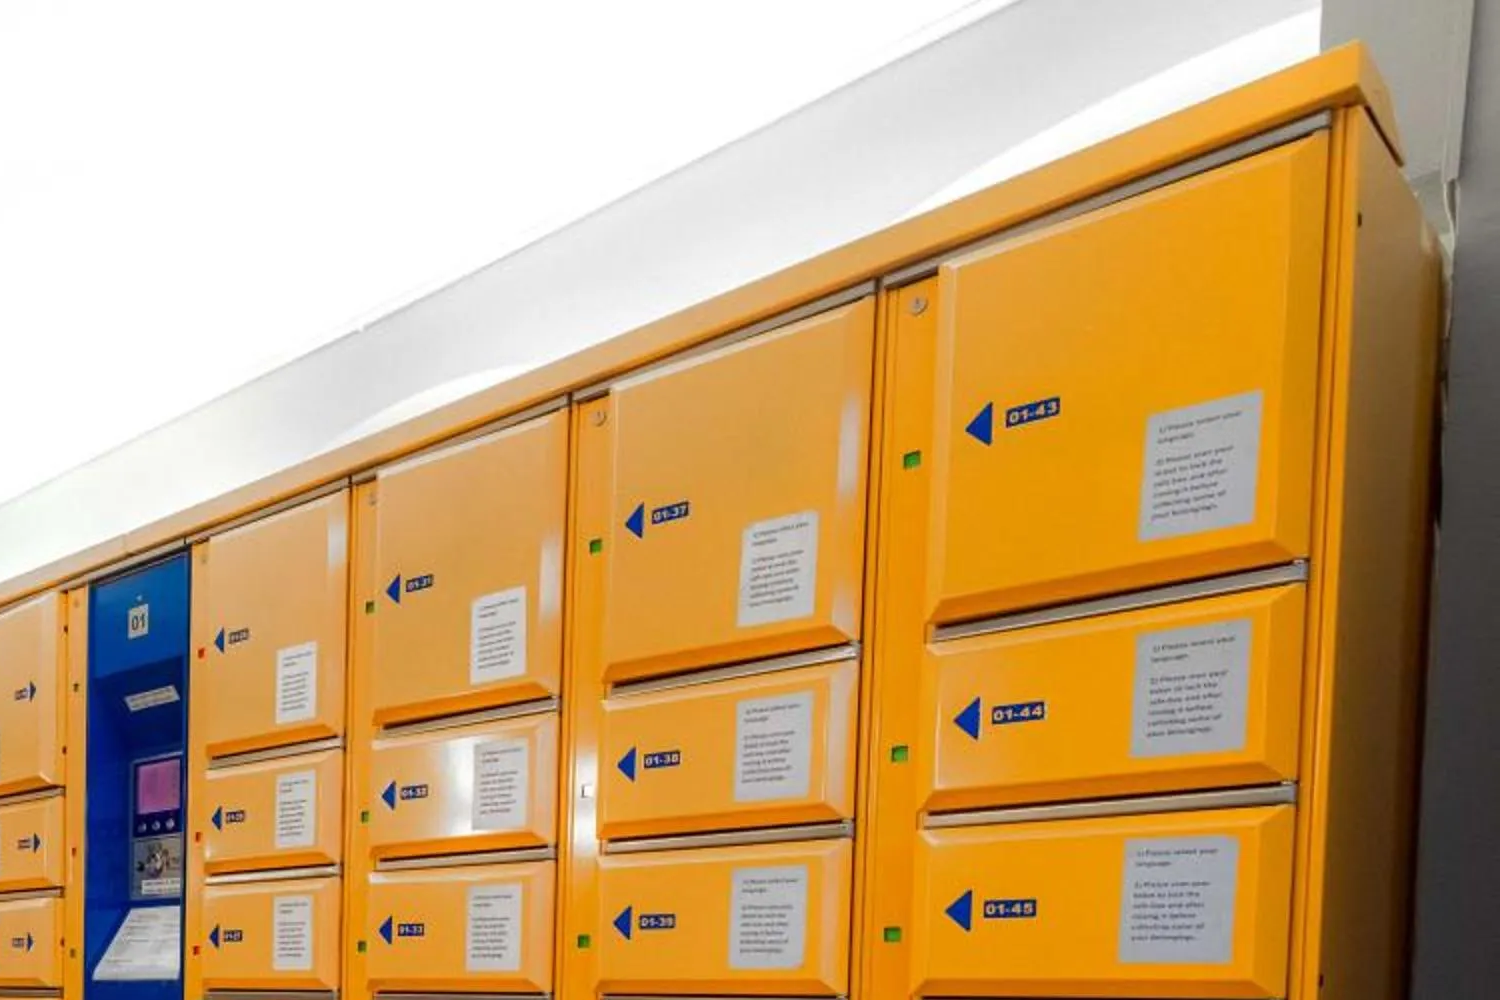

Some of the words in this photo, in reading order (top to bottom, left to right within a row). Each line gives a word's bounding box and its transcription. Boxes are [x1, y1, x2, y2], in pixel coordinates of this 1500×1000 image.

[1009, 401, 1057, 423] 01-43
[653, 503, 687, 522] 01-37
[131, 613, 146, 631] 01
[993, 705, 1043, 721] 01-44
